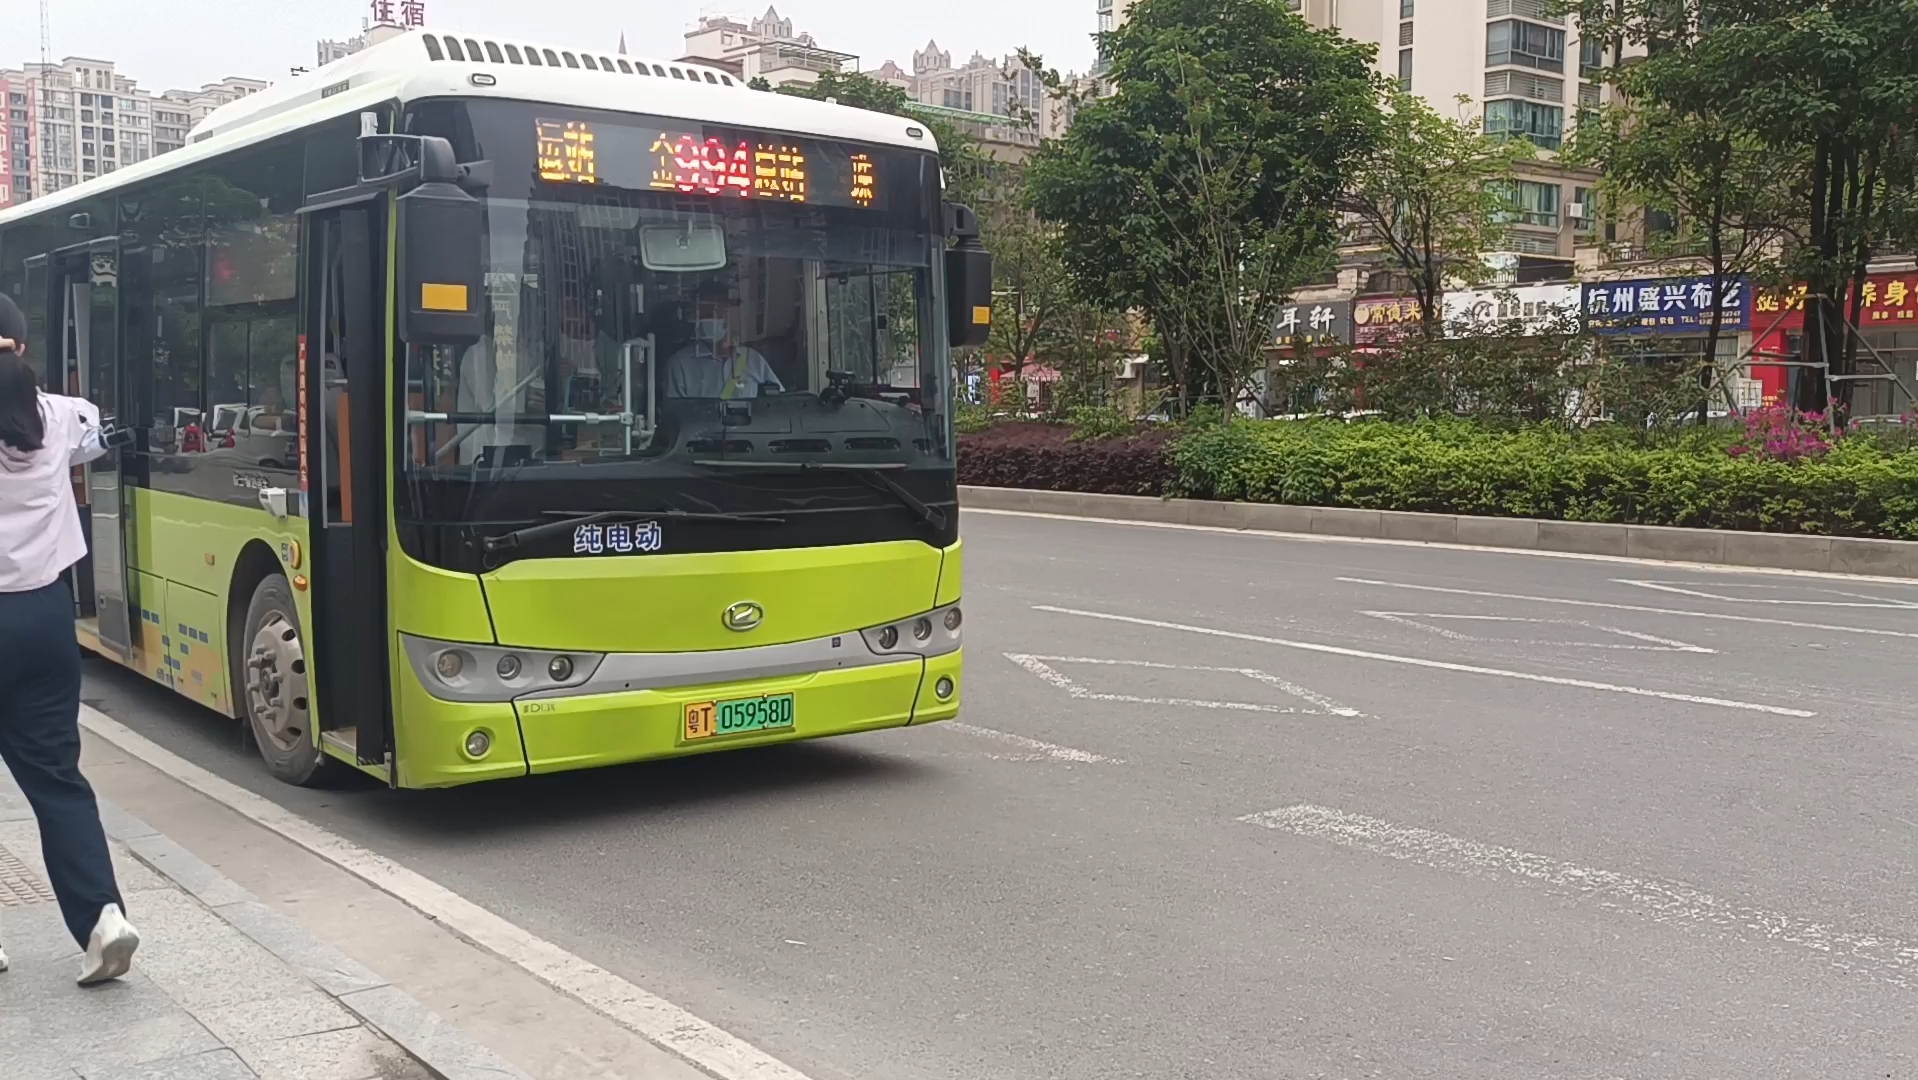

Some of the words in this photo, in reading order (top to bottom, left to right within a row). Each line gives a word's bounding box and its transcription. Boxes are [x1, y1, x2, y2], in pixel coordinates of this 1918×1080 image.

[370, 0, 424, 26] 住宿
[674, 134, 751, 196] 994
[1588, 280, 1741, 314] 杭州盛兴布艺
[573, 521, 662, 553] 纯电动
